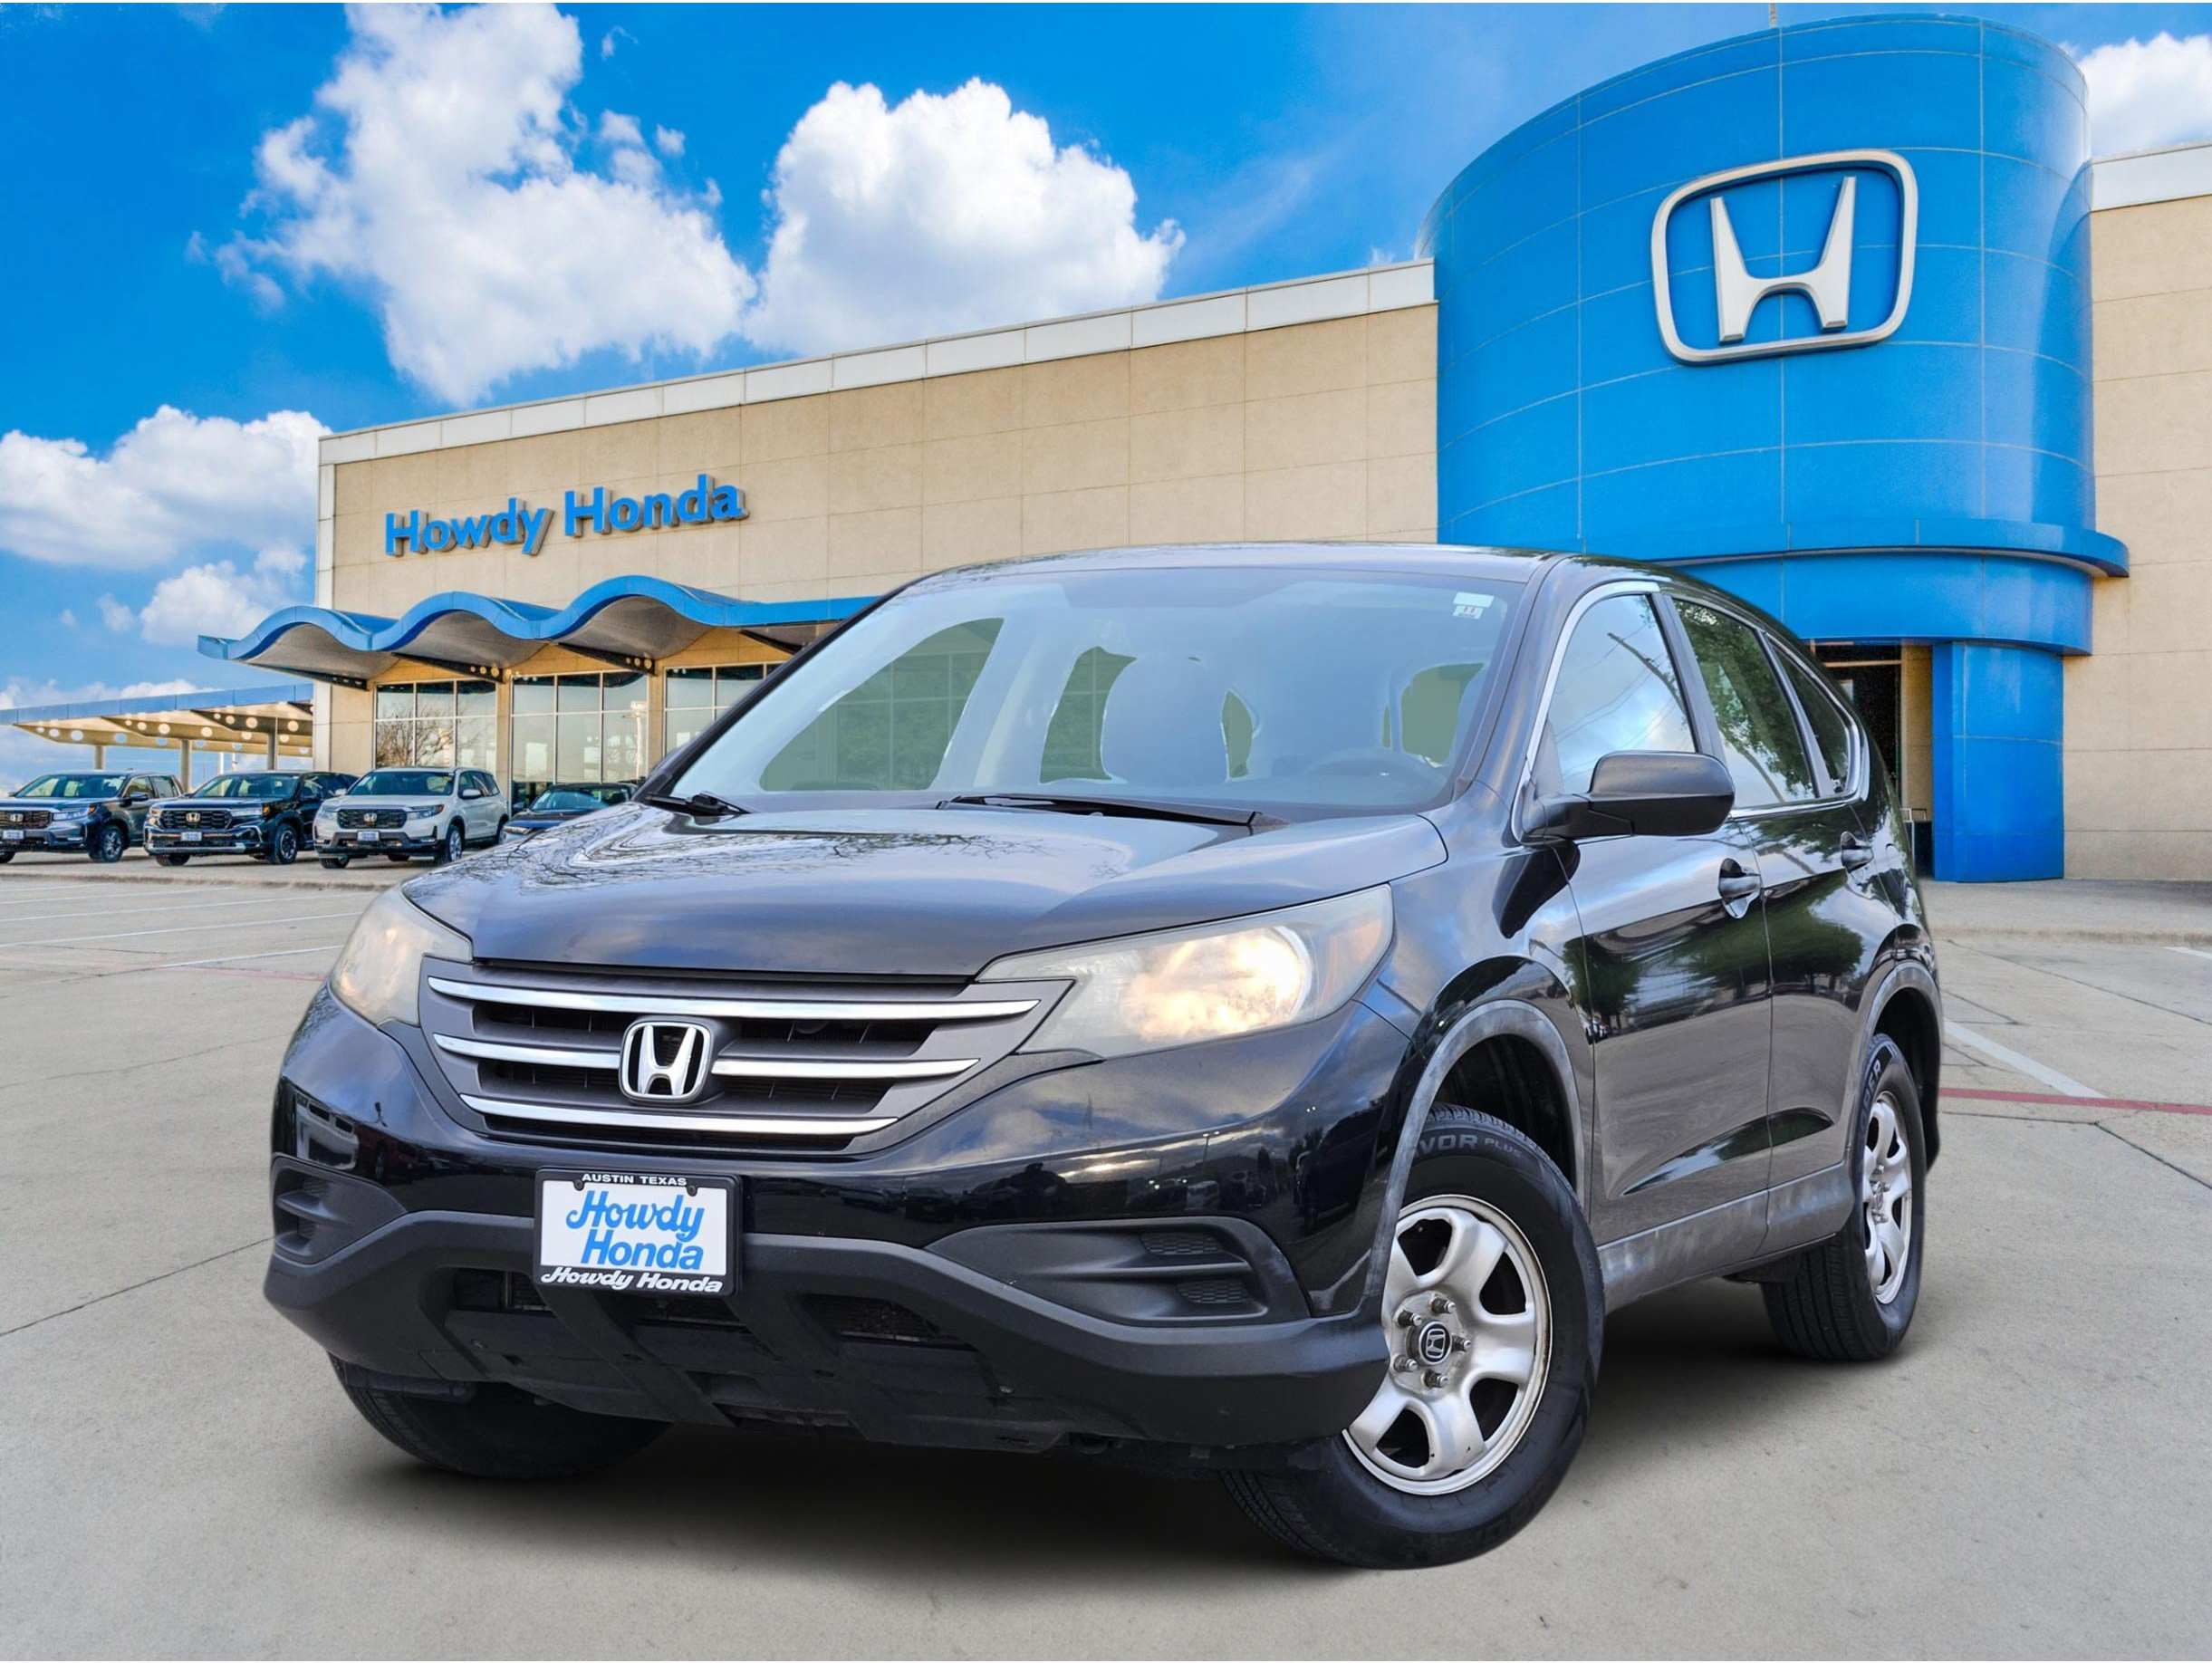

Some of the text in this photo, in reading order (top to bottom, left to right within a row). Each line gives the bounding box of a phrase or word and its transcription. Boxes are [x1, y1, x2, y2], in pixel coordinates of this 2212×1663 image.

[385, 474, 745, 555] Howdy Honda
[1415, 1134, 1478, 1156] VOR
[582, 1173, 688, 1187] AUSTIN TEXAS
[565, 1189, 706, 1243] Howdy
[581, 1228, 705, 1271] Honda
[541, 1266, 724, 1293] Howdy Honda
